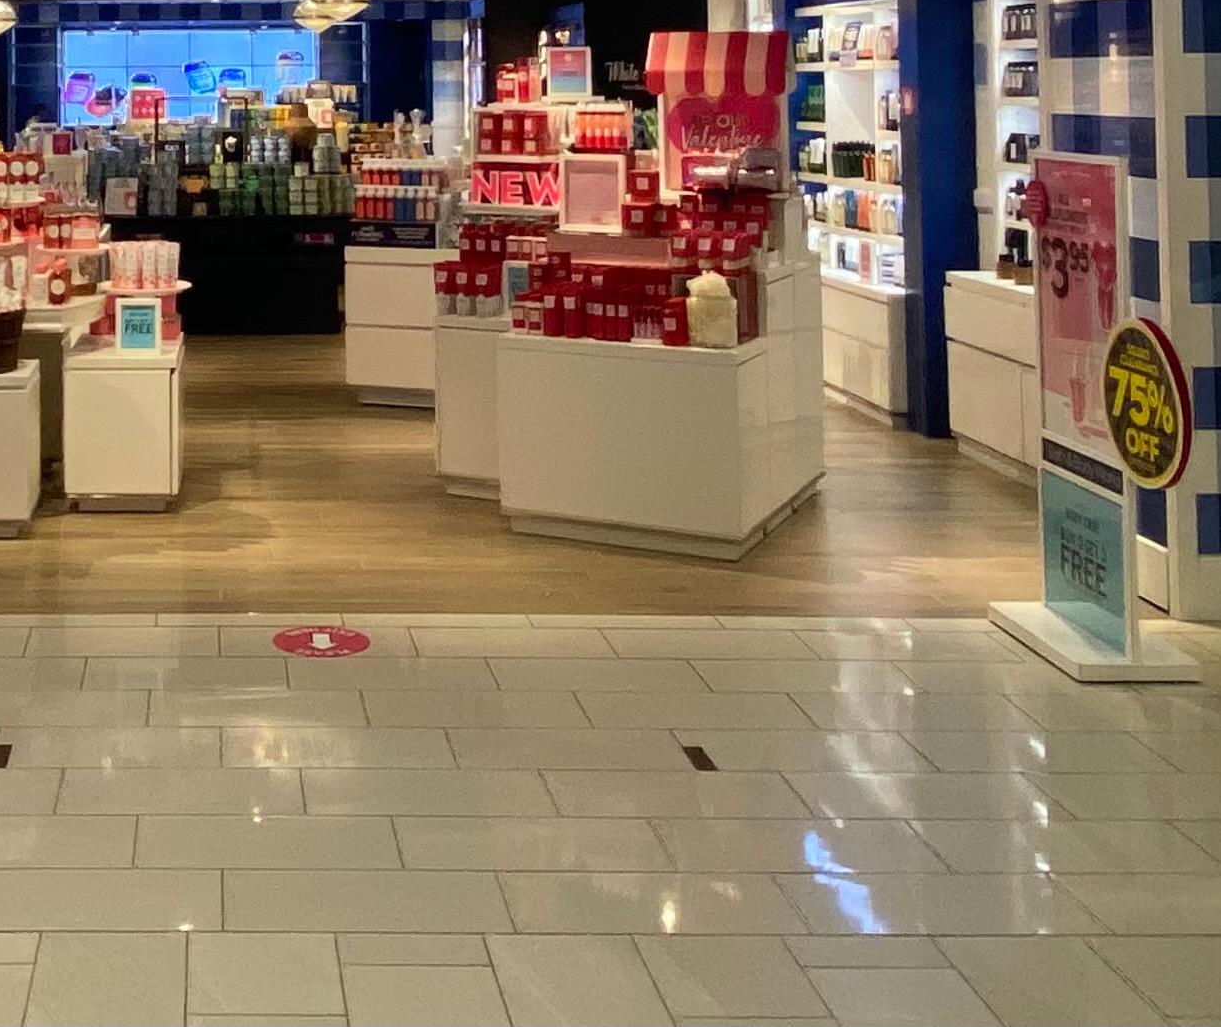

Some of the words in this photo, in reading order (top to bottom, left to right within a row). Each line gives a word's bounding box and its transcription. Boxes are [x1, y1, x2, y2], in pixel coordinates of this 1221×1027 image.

[470, 169, 563, 207] NEW
[1109, 365, 1175, 434] 75%
[1125, 427, 1160, 463] OFF
[1060, 542, 1108, 598] FREE
